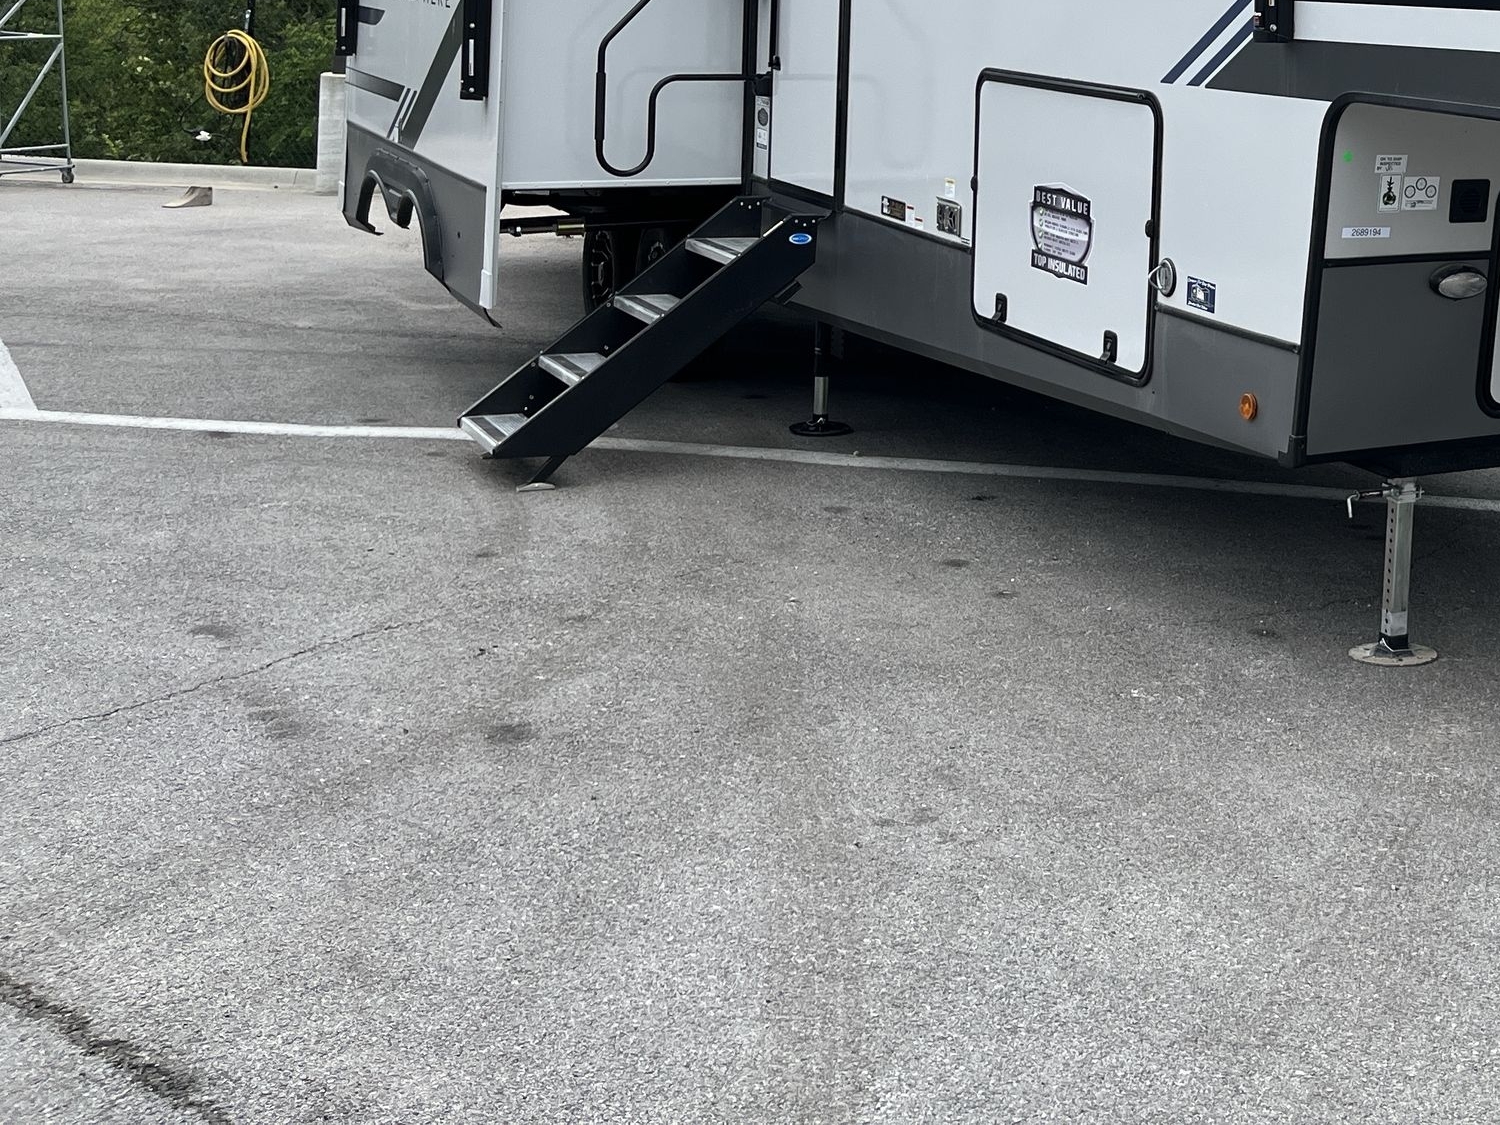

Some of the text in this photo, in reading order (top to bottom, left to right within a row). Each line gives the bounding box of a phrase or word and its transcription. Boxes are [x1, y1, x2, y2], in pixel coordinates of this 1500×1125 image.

[1035, 189, 1089, 215] BEST VALUE
[1351, 228, 1382, 237] 2689194
[1033, 252, 1086, 281] TOP INSULATED
